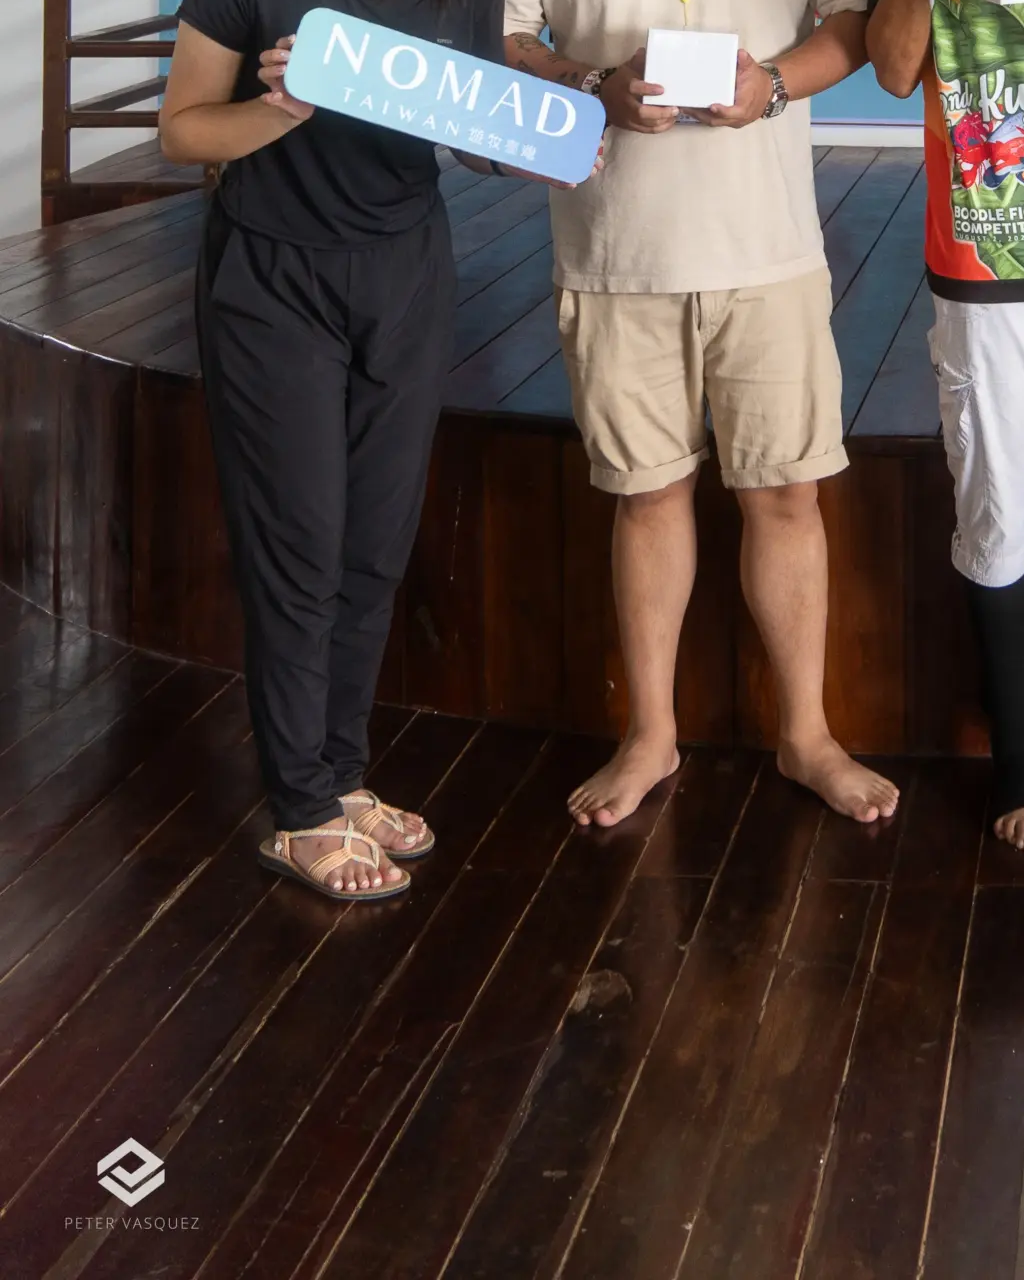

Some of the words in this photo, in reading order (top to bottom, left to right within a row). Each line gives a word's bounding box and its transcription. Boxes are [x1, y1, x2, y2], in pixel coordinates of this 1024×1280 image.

[322, 22, 577, 138] NOMAD
[343, 86, 461, 137] TAIWAN
[954, 205, 1005, 222] BOODLE
